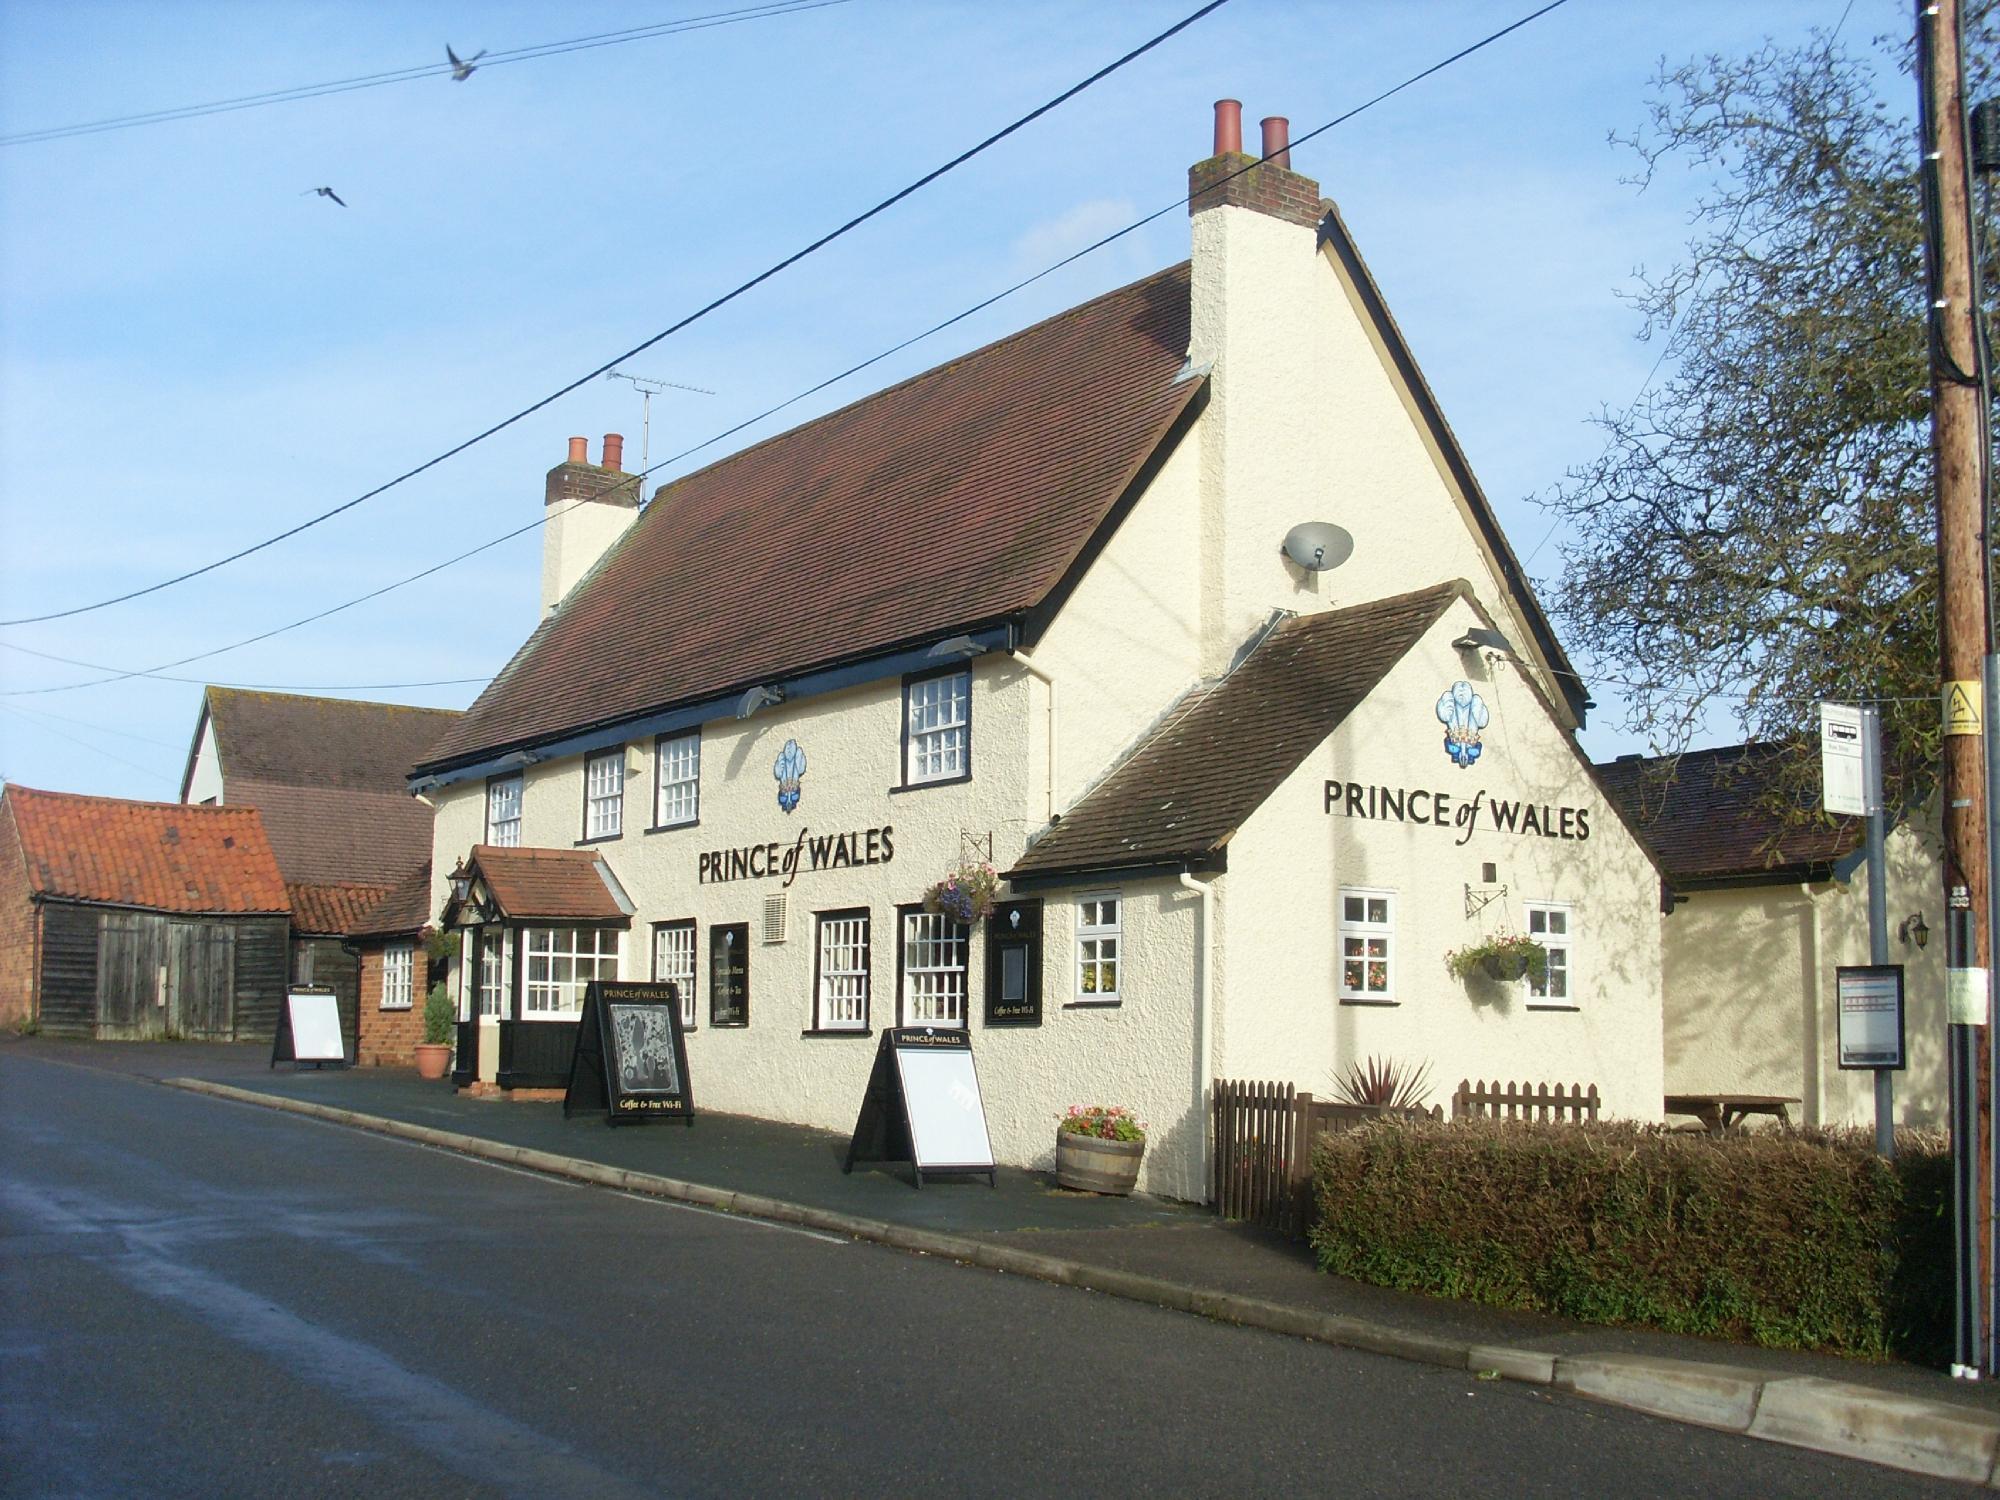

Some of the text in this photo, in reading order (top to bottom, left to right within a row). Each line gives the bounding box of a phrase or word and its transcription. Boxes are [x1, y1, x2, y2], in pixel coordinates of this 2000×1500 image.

[1324, 780, 1590, 846] PRINCE of WALES
[700, 825, 894, 888] PRINCE of WALES
[603, 988, 670, 1001] PRINCE of WALES
[901, 1034, 961, 1046] PRINCE of WALES
[620, 1099, 639, 1110] Coffee
[640, 1100, 648, 1109] &
[648, 1100, 661, 1109] Free
